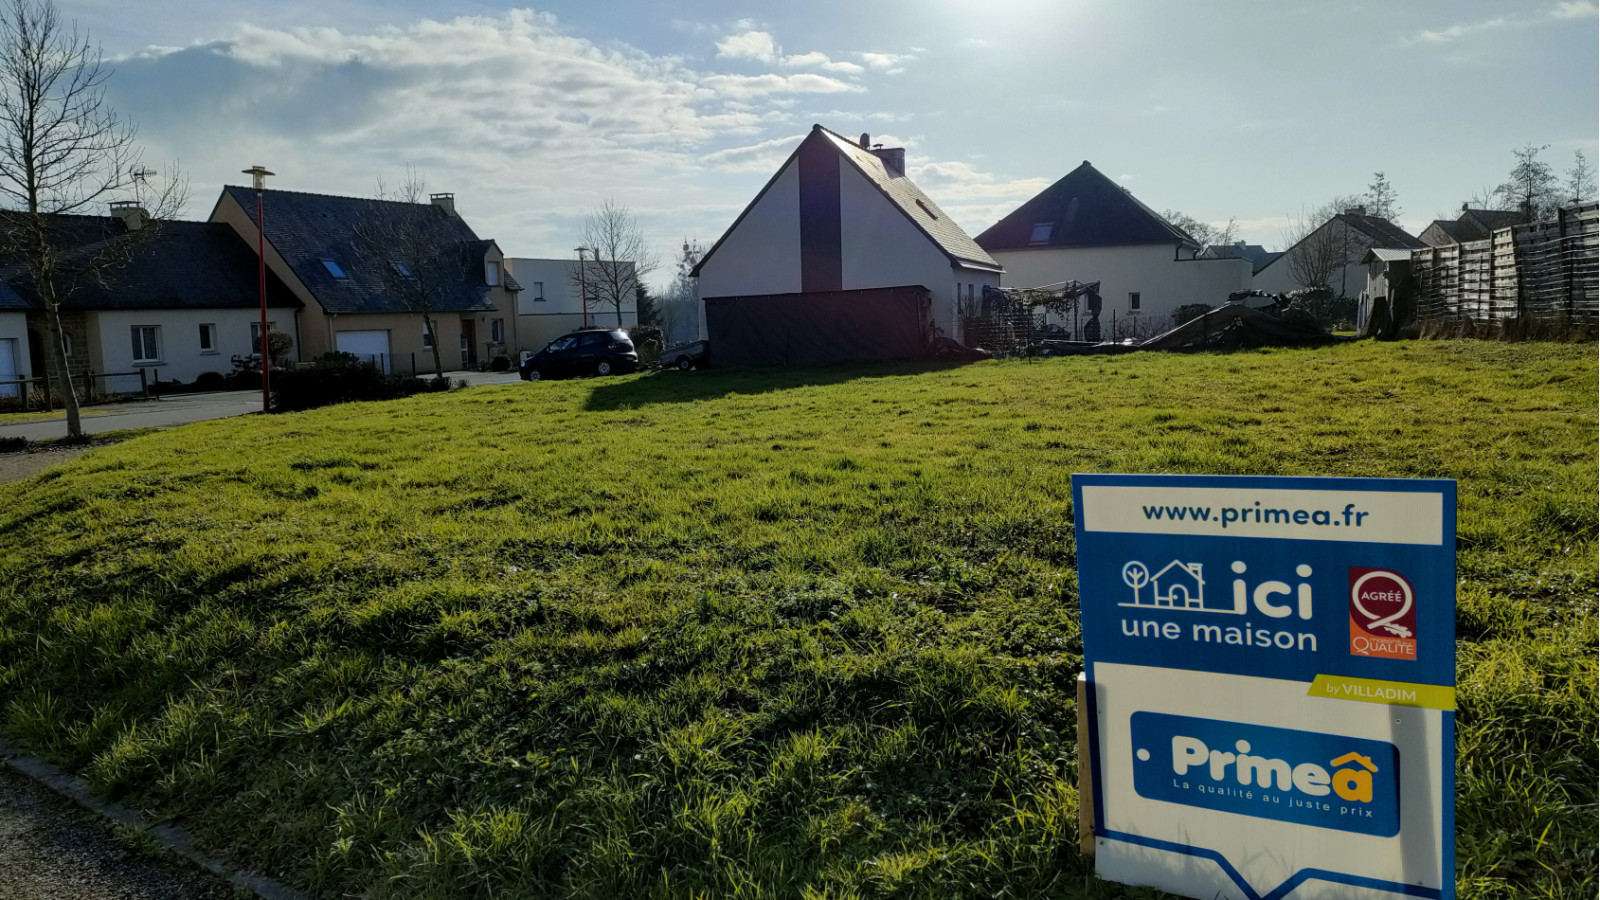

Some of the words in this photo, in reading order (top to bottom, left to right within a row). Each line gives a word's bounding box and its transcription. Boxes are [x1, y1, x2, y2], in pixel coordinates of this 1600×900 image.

[1142, 501, 1369, 528] www.primea.fr
[1231, 560, 1313, 620] ici
[1361, 590, 1402, 602] AGRÉÉ
[1121, 619, 1181, 640] une
[1193, 622, 1317, 651] maison
[1352, 636, 1414, 655] QUALITÉ
[1326, 683, 1340, 695] by
[1342, 683, 1417, 702] VILLADIM
[1173, 778, 1189, 789] La
[1198, 784, 1253, 799] qualité
[1262, 794, 1280, 804] au
[1289, 797, 1330, 811] juste
[1340, 806, 1373, 818] prix
